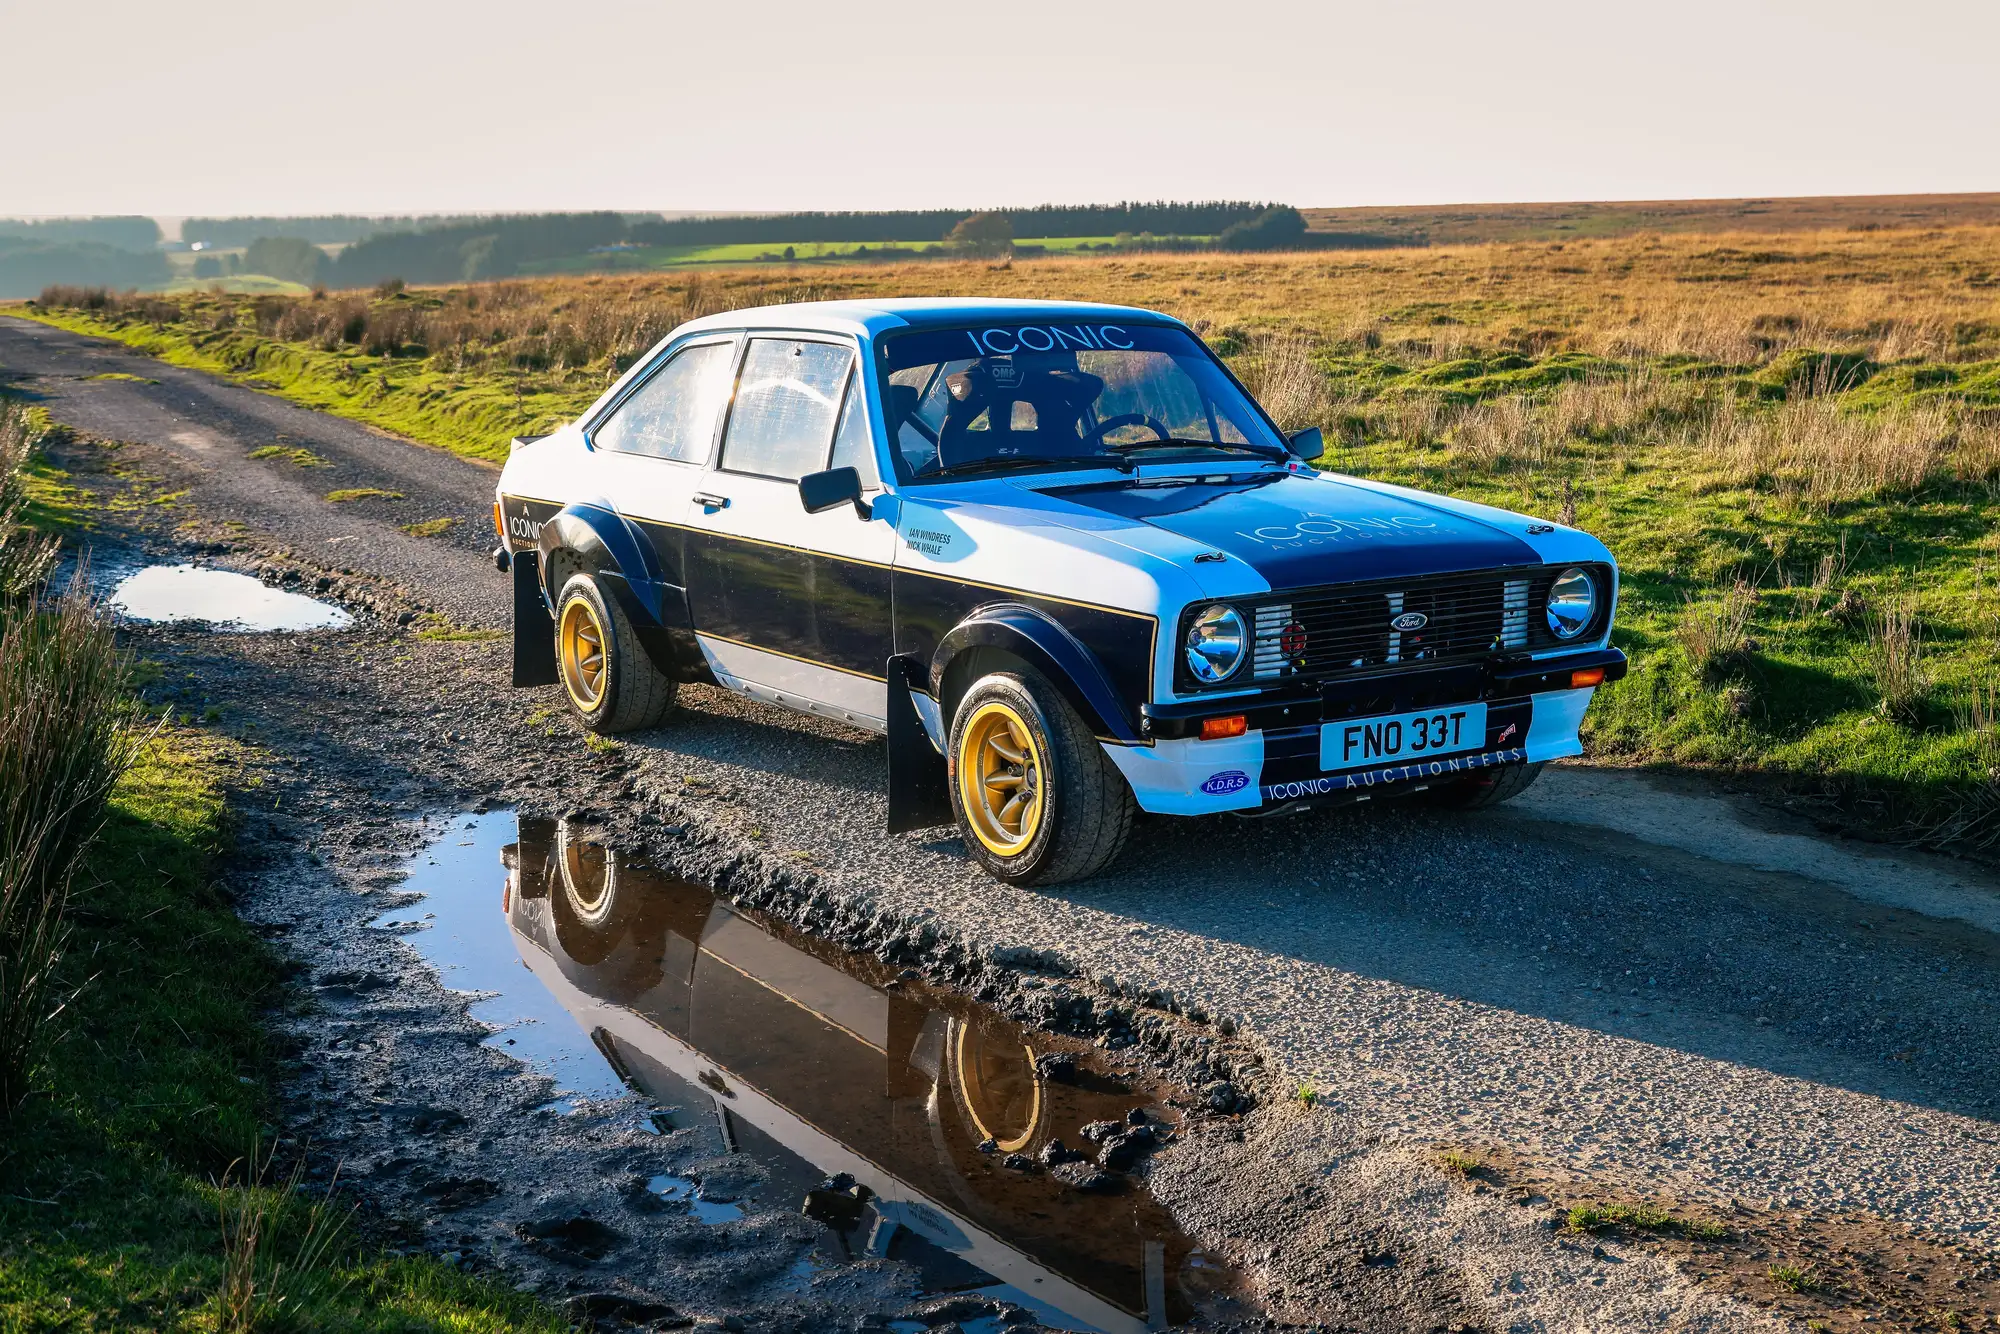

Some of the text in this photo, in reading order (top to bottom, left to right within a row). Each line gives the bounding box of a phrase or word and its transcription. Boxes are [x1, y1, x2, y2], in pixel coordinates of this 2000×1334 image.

[966, 325, 1135, 355] ICONIC
[992, 367, 1016, 379] OMP
[909, 528, 951, 545] IAN WINDRESS
[1235, 516, 1437, 544] ICONIC
[906, 540, 943, 556] NICK WHALE
[1400, 616, 1420, 628] Ford
[1343, 711, 1467, 762] FNO 33T
[1268, 747, 1521, 801] ICONIC AUCTIONEERS
[1206, 777, 1244, 791] K.D.R.S
